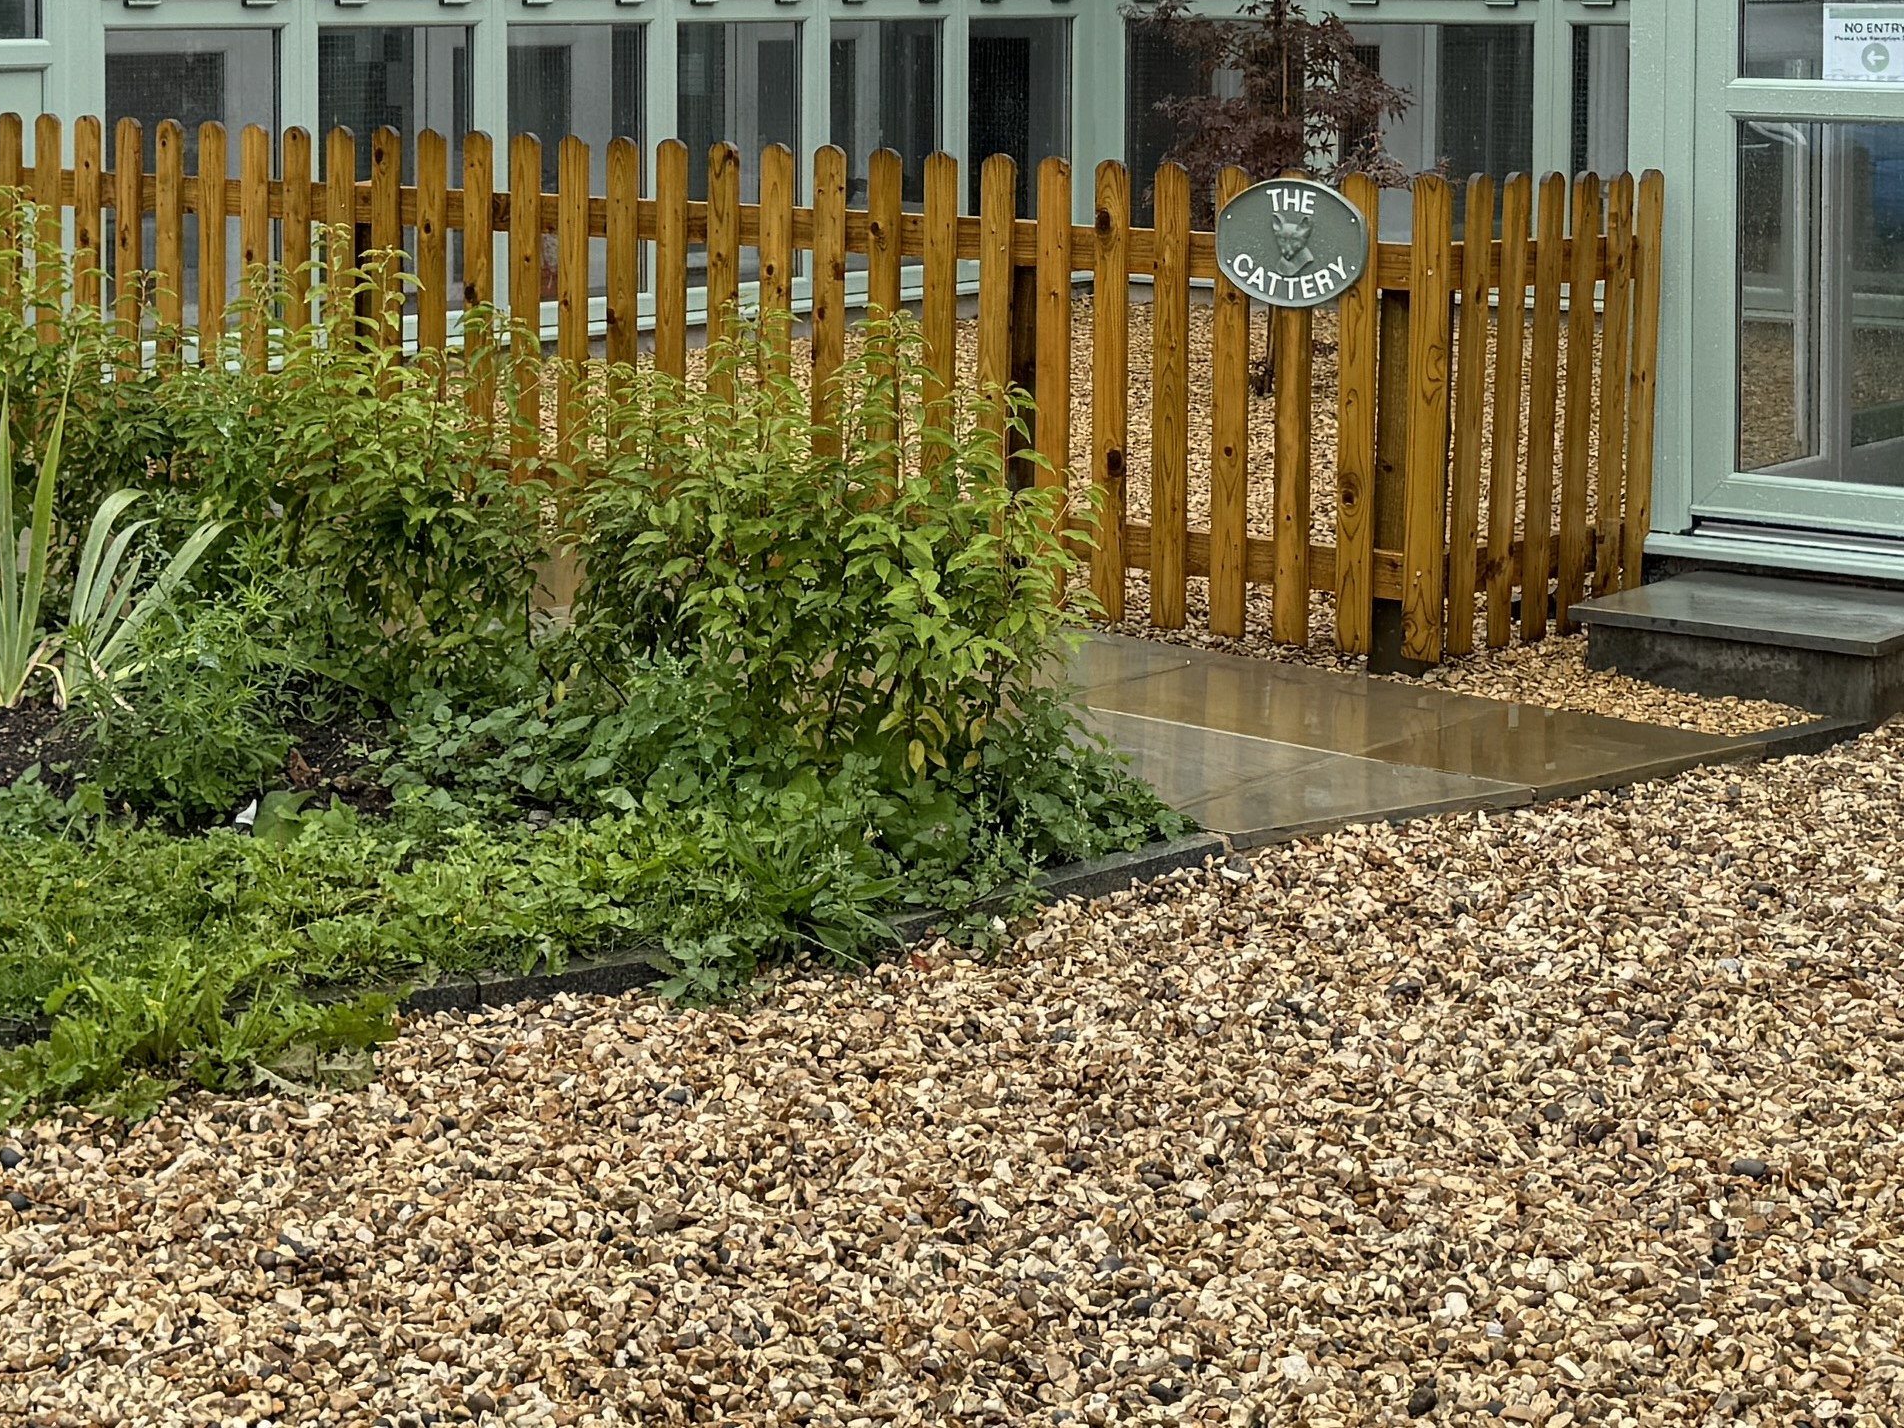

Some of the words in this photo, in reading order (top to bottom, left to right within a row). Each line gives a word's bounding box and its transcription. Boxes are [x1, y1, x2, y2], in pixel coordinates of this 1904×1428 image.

[1844, 23, 1863, 33] NO
[1266, 188, 1316, 214] THE
[1233, 253, 1347, 300] CATTERY
